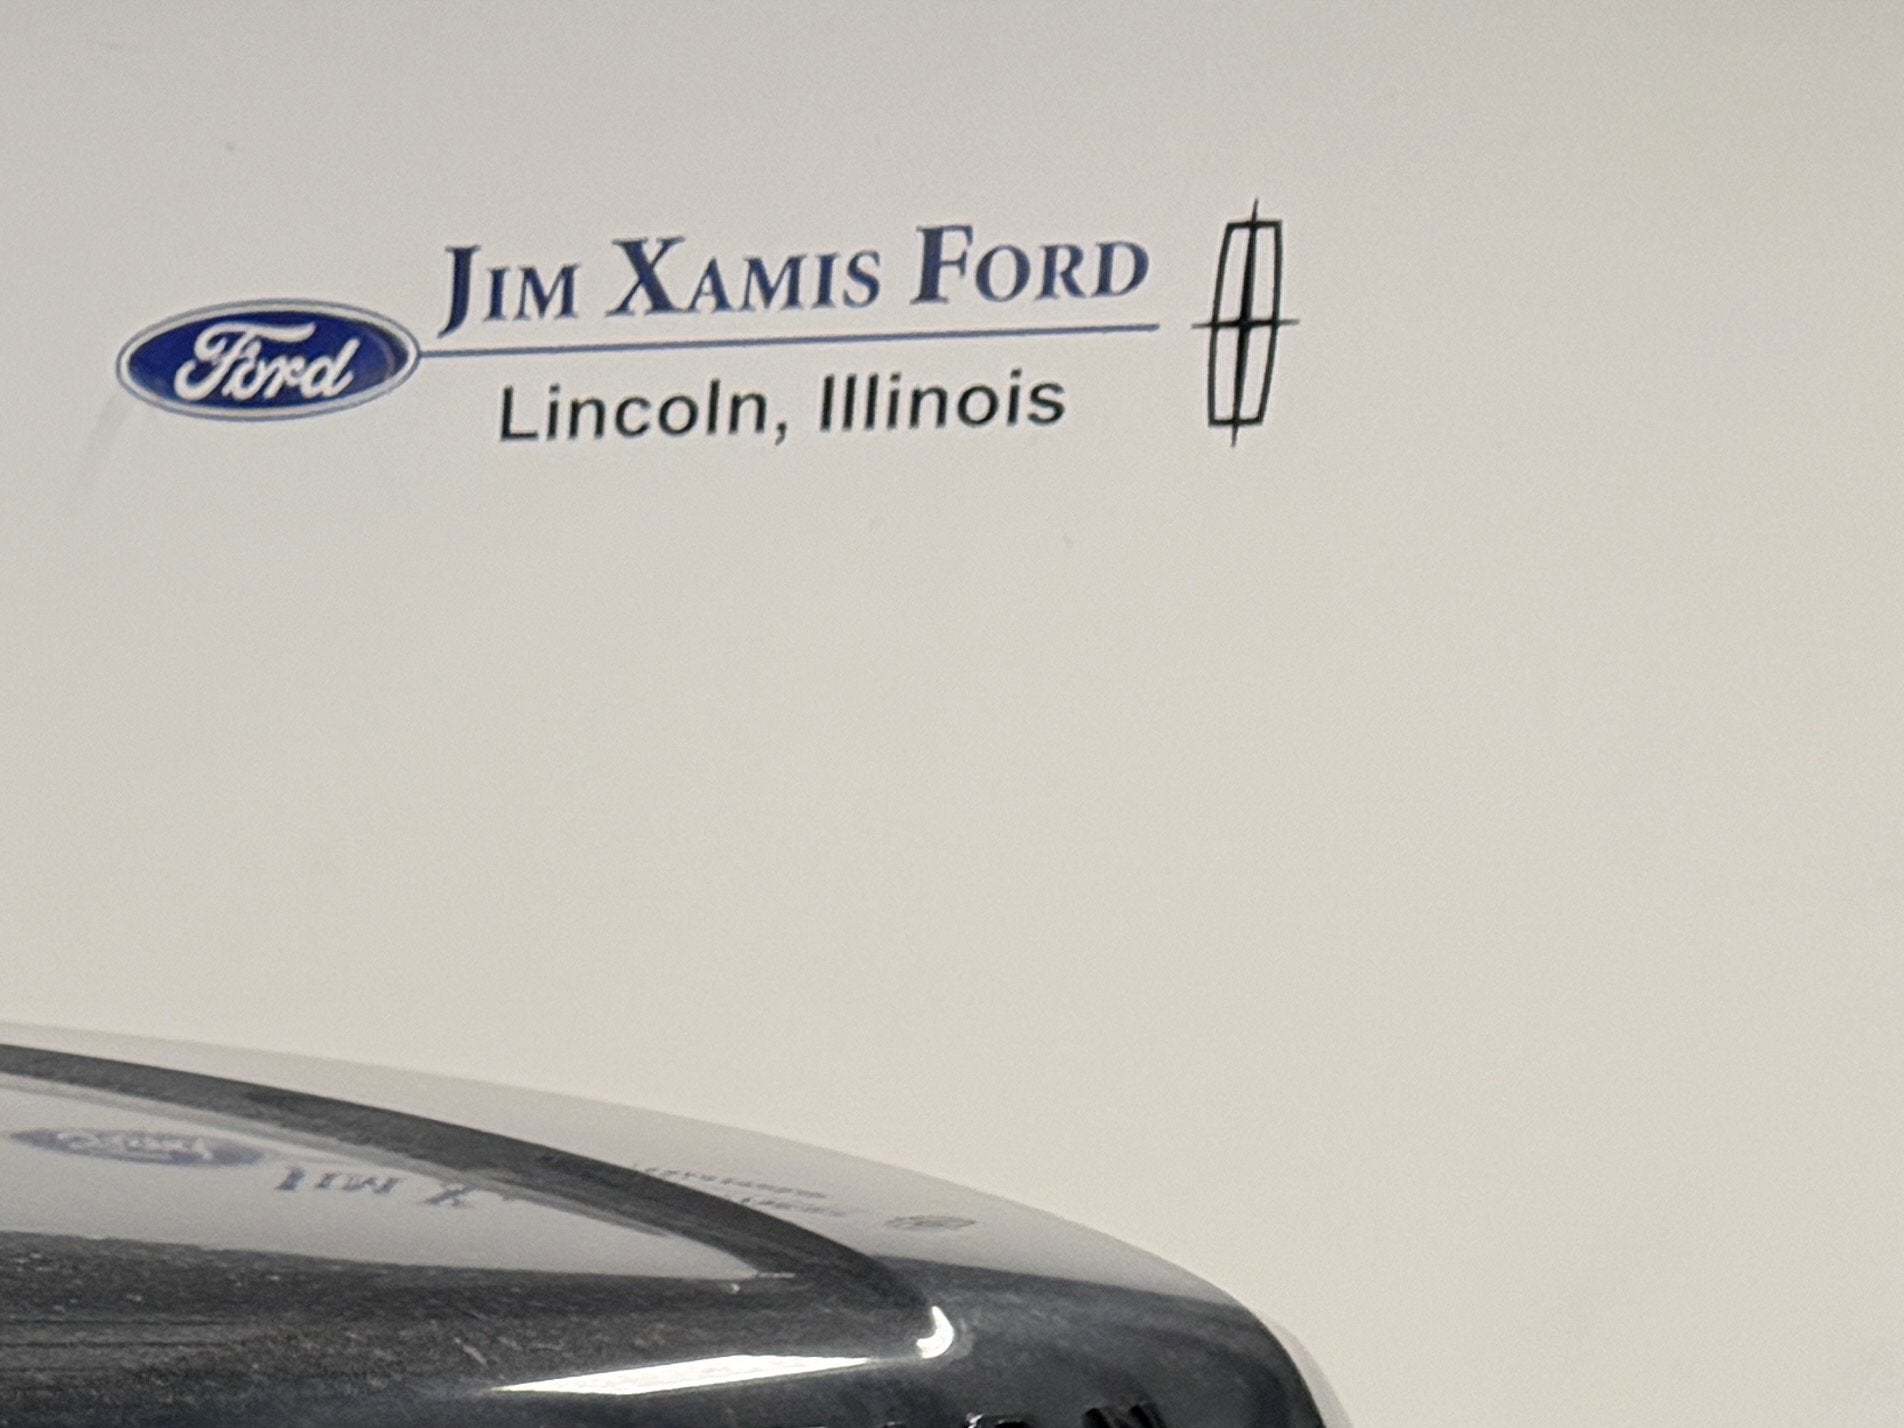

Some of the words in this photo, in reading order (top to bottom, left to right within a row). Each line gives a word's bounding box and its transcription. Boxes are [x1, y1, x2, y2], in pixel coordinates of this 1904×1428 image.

[175, 322, 354, 401] Ford
[498, 377, 790, 446] Lincoln,
[818, 368, 1068, 434] Illinois
